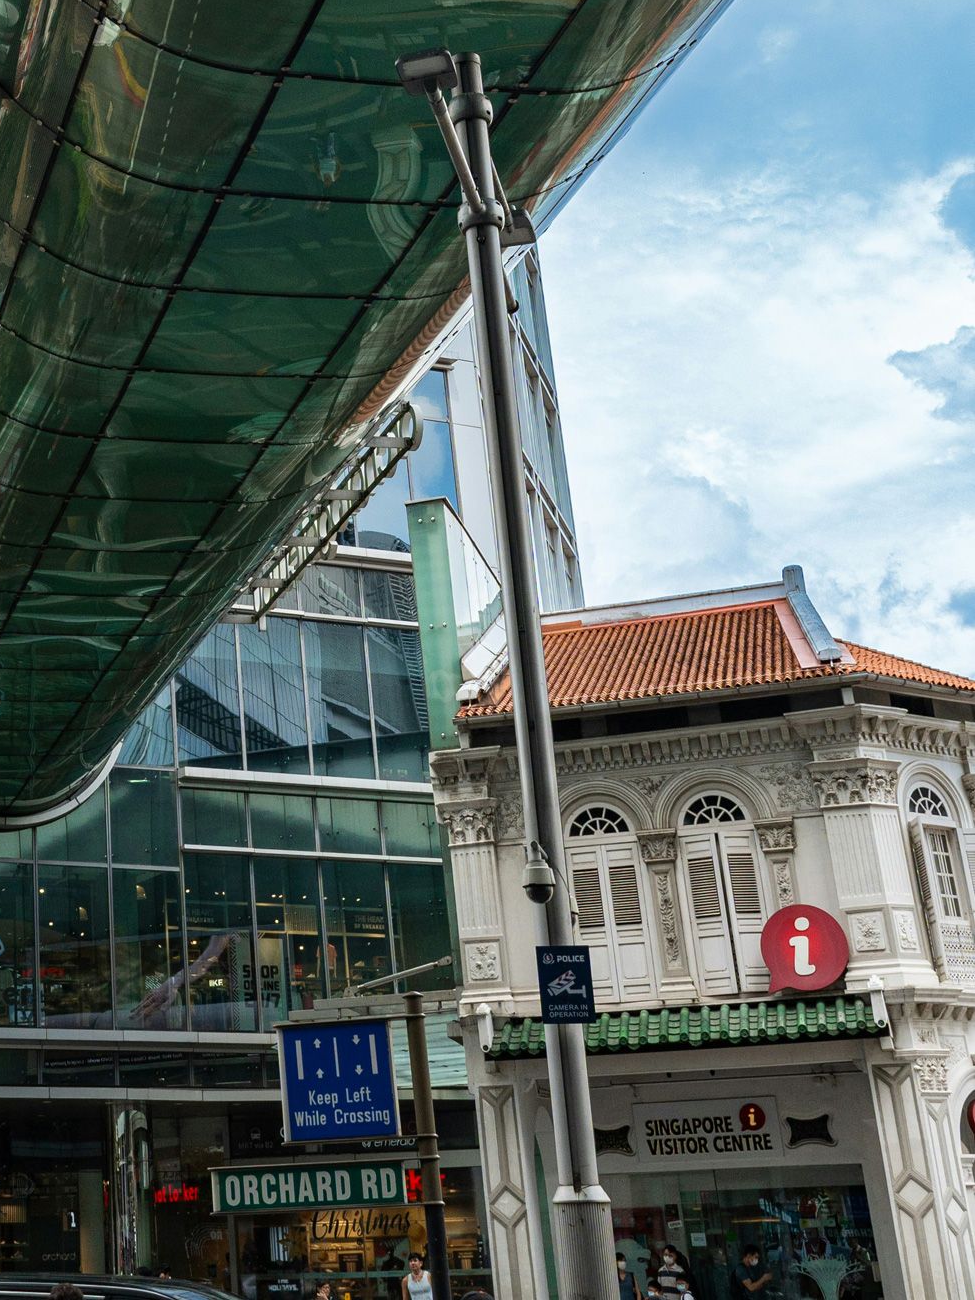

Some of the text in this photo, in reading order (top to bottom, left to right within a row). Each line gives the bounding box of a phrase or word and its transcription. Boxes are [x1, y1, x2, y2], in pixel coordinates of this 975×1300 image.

[243, 965, 279, 978] SOP
[309, 1086, 371, 1108] Keep Left
[295, 1106, 390, 1126] While Crossing
[645, 1116, 733, 1137] SINGAPORE
[647, 1134, 773, 1156] VISITOR CENTRE
[225, 1170, 351, 1207] ORCHARD
[361, 1168, 397, 1199] RD
[310, 1210, 411, 1241] Christmas
